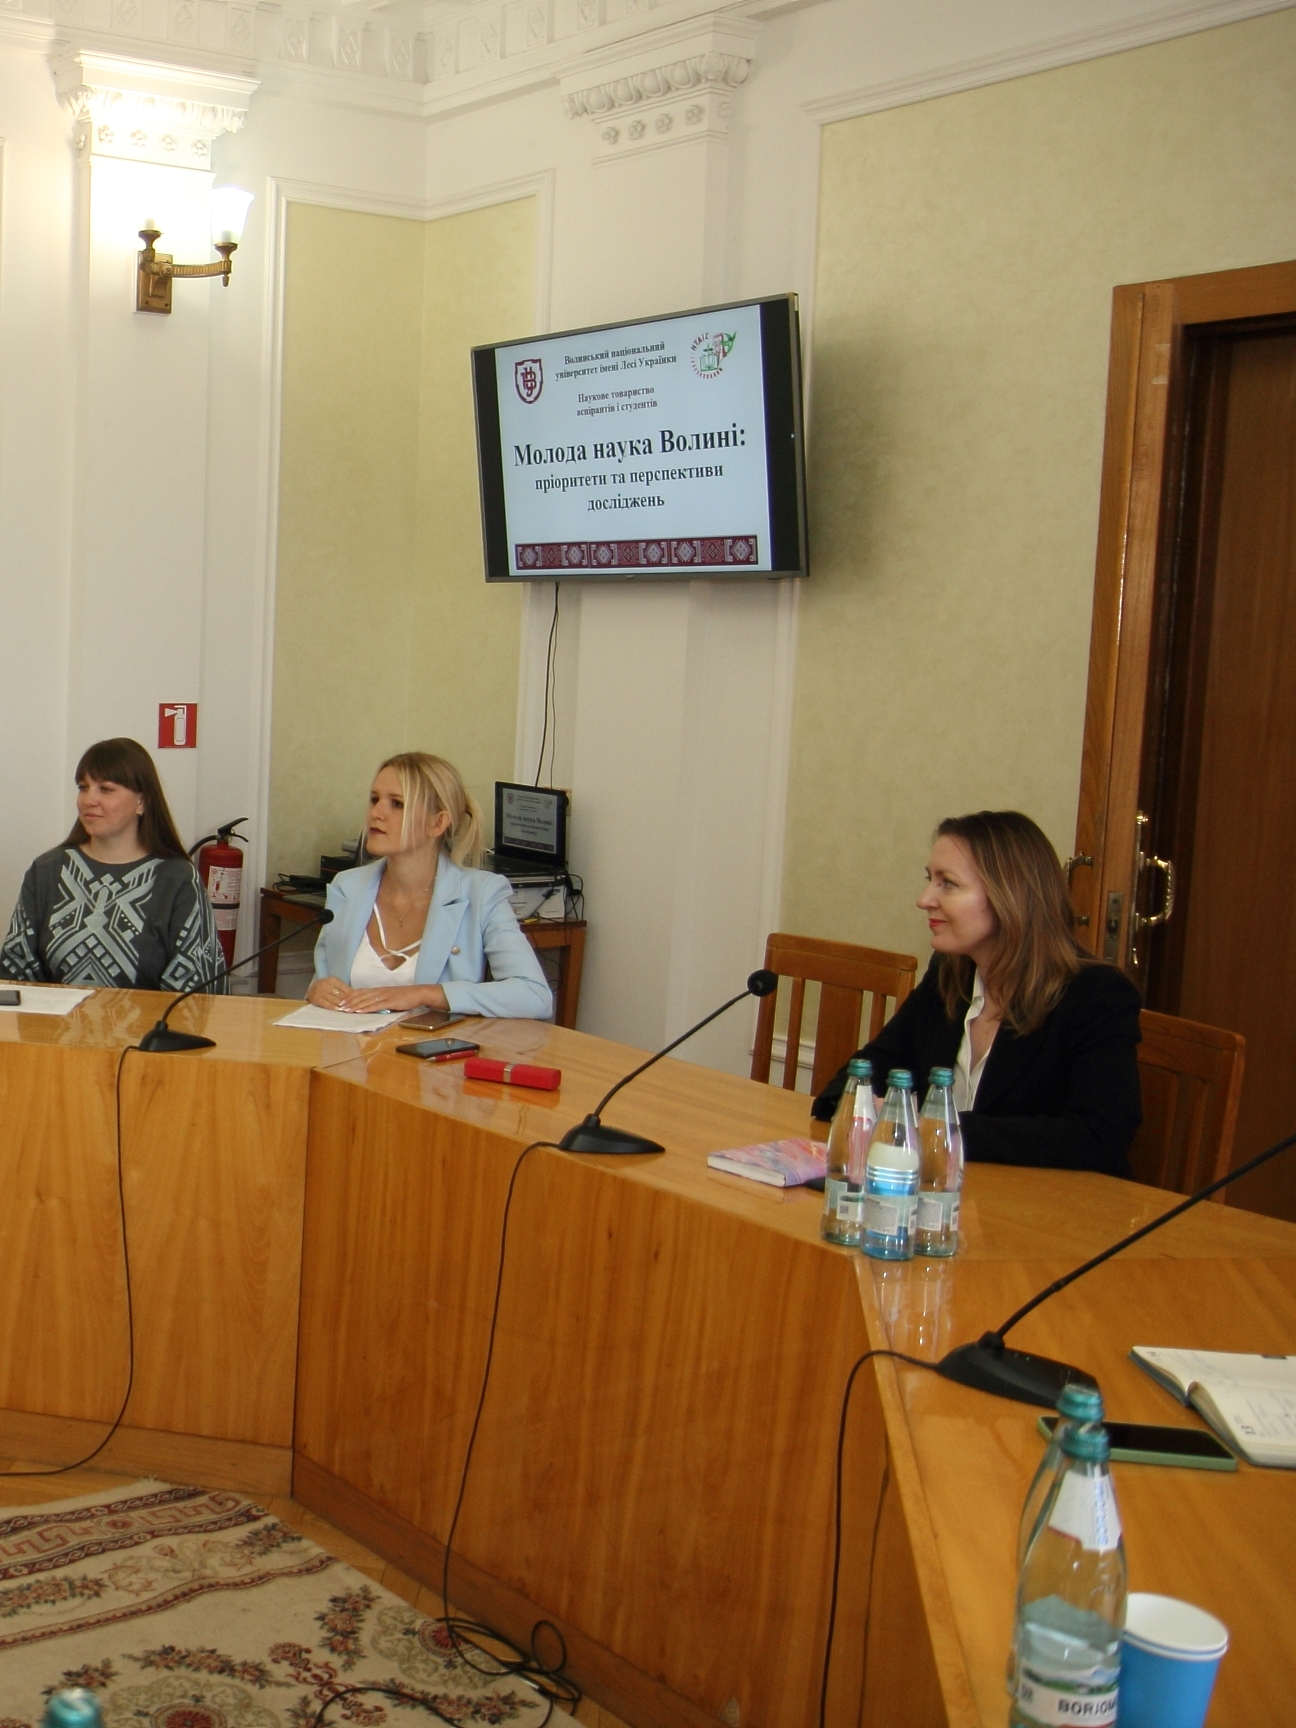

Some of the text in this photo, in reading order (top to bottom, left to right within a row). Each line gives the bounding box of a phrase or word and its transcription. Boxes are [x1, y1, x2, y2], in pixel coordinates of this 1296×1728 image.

[564, 341, 665, 365] Волинський національний
[555, 367, 598, 382] університет
[599, 362, 619, 373] імені
[620, 360, 637, 371] Лесі
[638, 355, 677, 369] Українки
[578, 386, 655, 404] Наукове товариство
[576, 403, 615, 417] аспірантів
[620, 398, 658, 413] студентів
[513, 422, 746, 467] Молода наука Волині:
[535, 464, 724, 494] пріоритети та перспективи
[587, 493, 665, 512] досліджень
